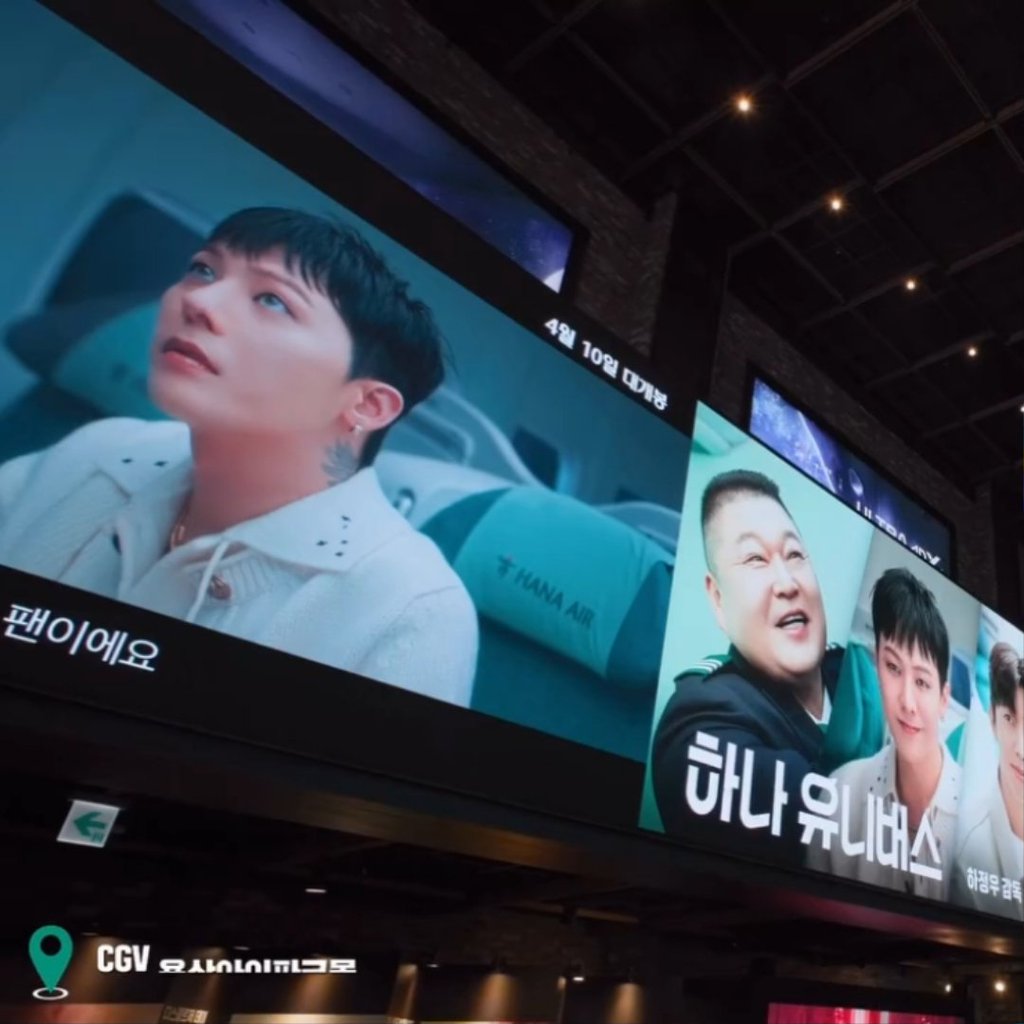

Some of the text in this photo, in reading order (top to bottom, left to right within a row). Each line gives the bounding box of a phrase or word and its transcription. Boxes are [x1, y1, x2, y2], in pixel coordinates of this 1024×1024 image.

[544, 318, 669, 411] 4월 10일 대개봉
[514, 568, 596, 631] HANA AIR
[3, 604, 159, 672] 팬이에요
[685, 730, 943, 881] 하나 유니버스
[966, 867, 1000, 897] 하정우
